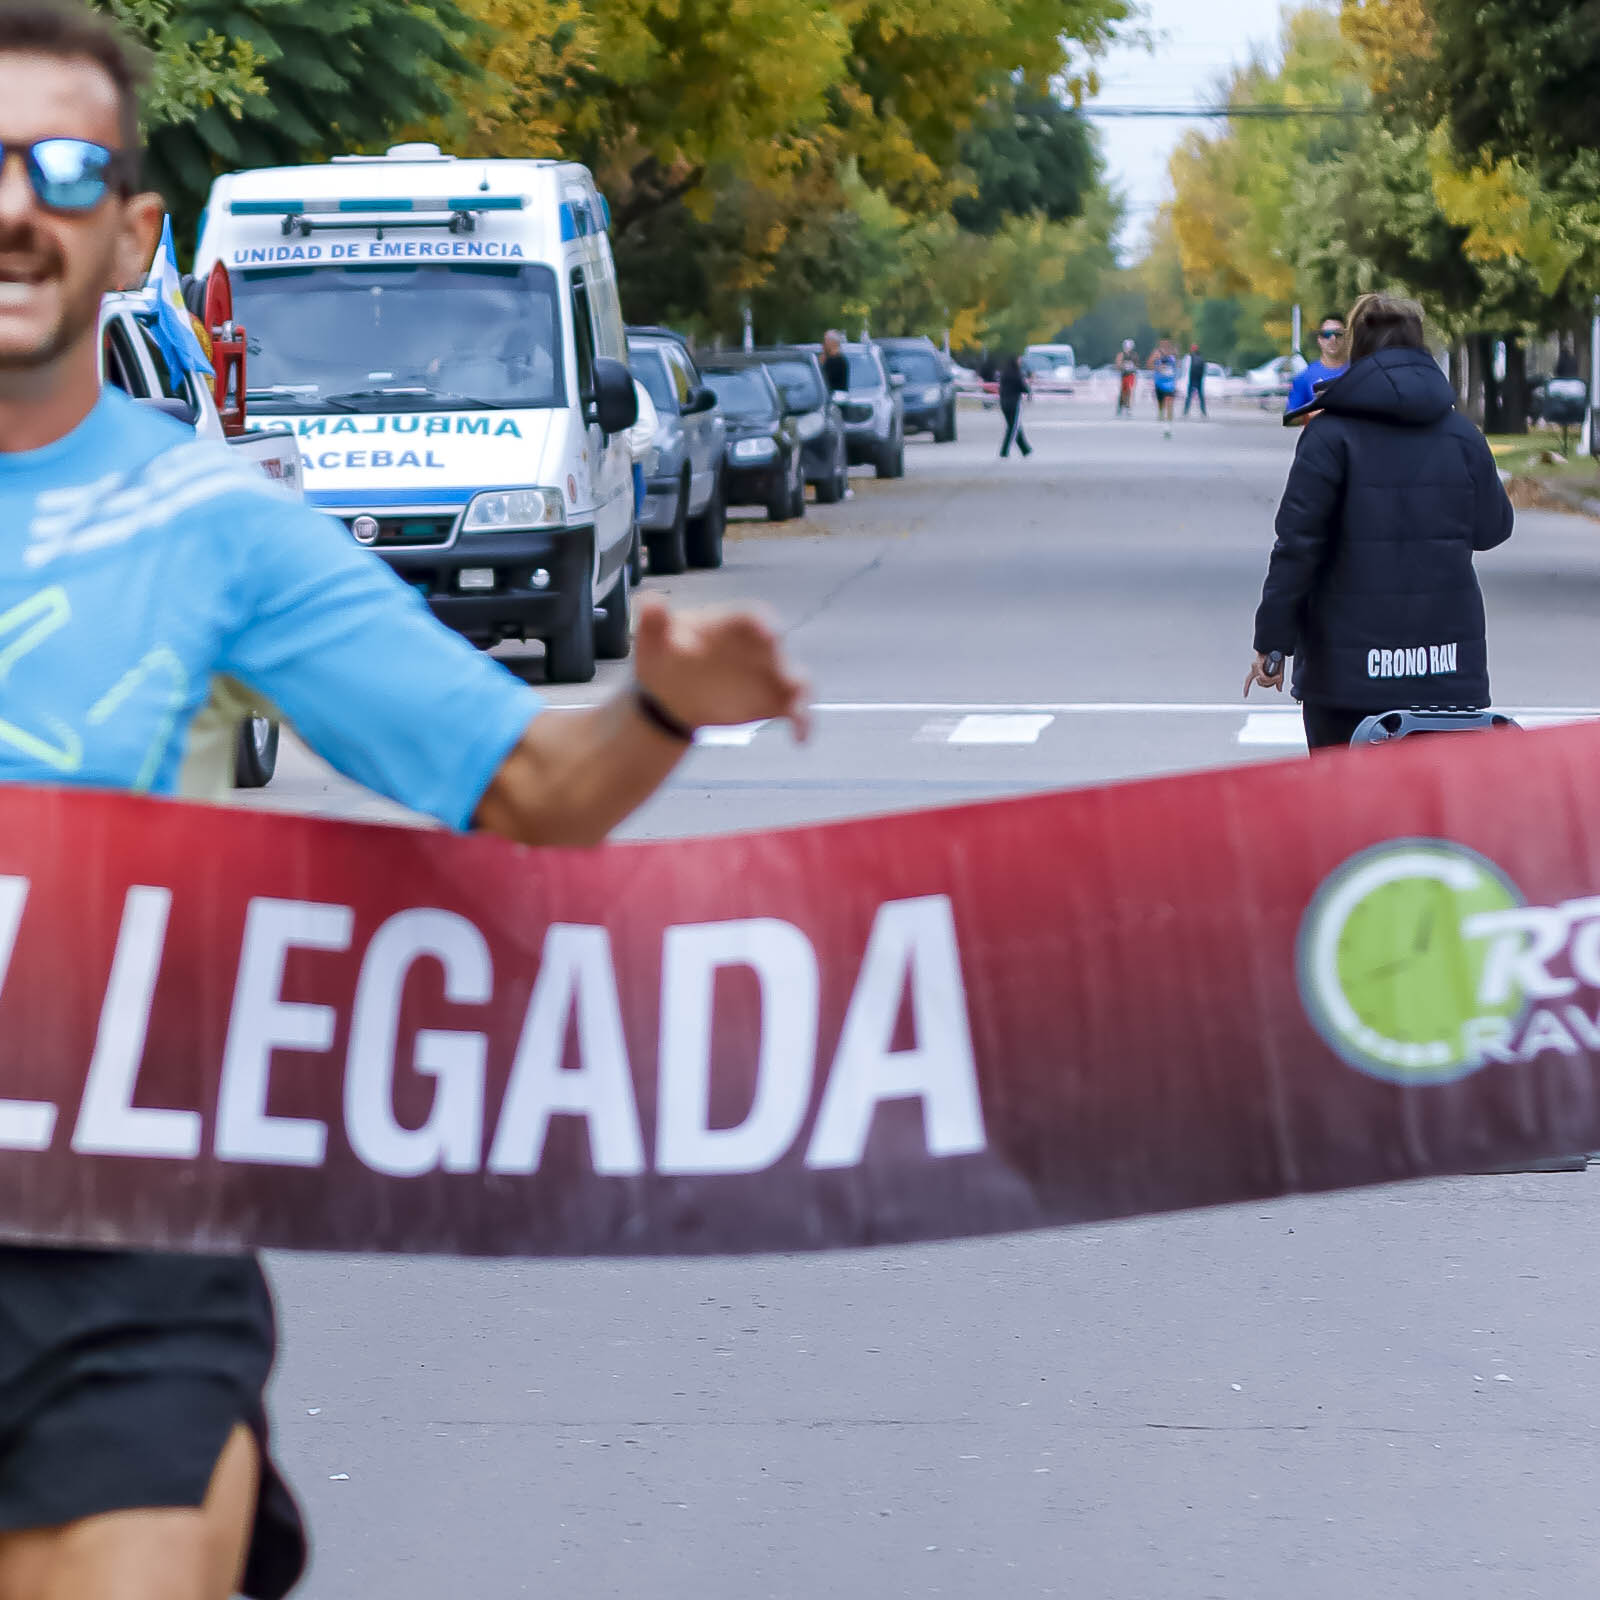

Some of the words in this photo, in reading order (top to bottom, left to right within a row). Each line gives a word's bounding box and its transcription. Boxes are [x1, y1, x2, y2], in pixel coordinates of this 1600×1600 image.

[233, 245, 322, 264] UNIDAD
[330, 243, 360, 258] DE
[368, 241, 524, 258] EMERGENCIA
[1367, 647, 1428, 678] CRONO
[1429, 642, 1458, 674] RAV
